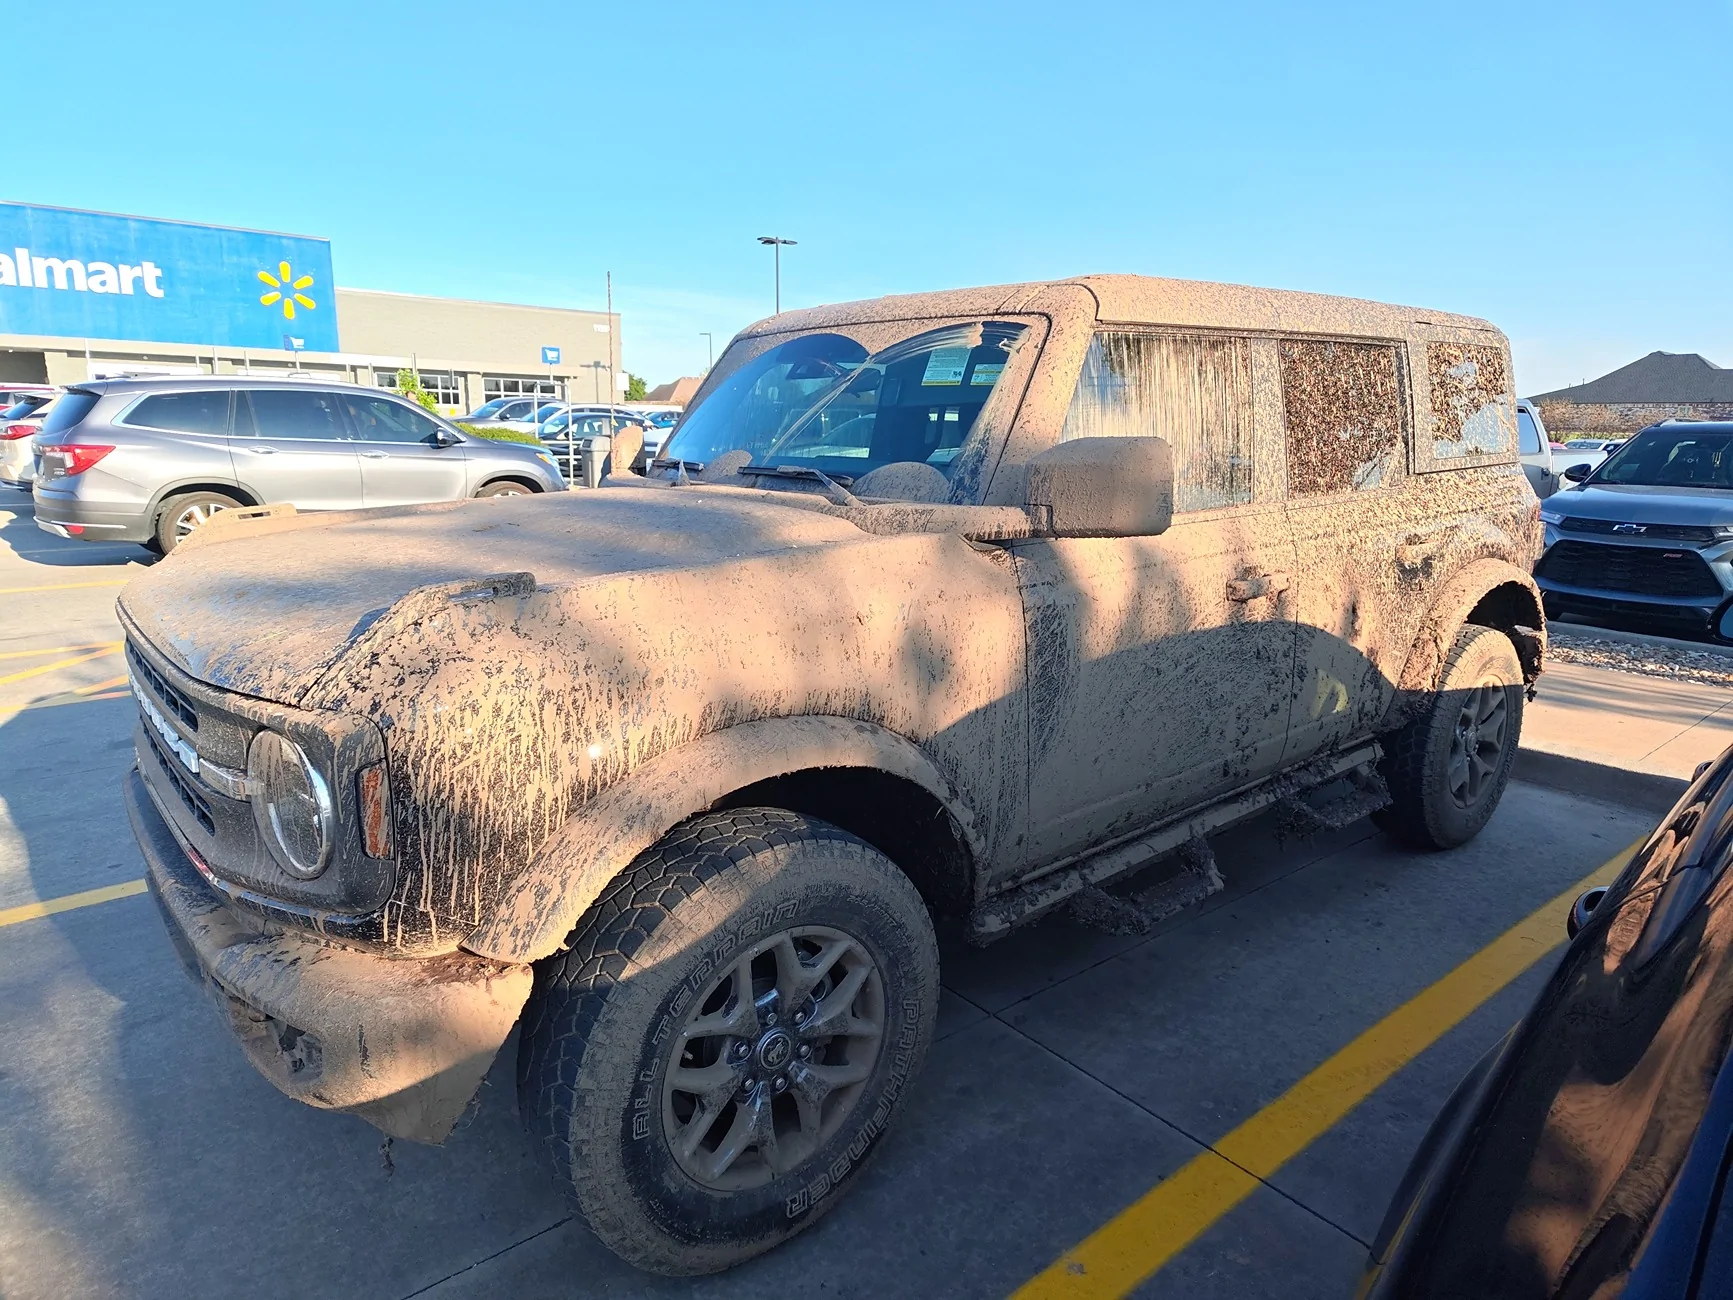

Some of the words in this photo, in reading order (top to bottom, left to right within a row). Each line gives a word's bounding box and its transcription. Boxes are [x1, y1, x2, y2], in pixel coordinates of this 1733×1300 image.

[632, 1057, 660, 1141] ALL
[652, 899, 800, 1046] TERRAIN
[785, 999, 920, 1219] PATHFINDER
